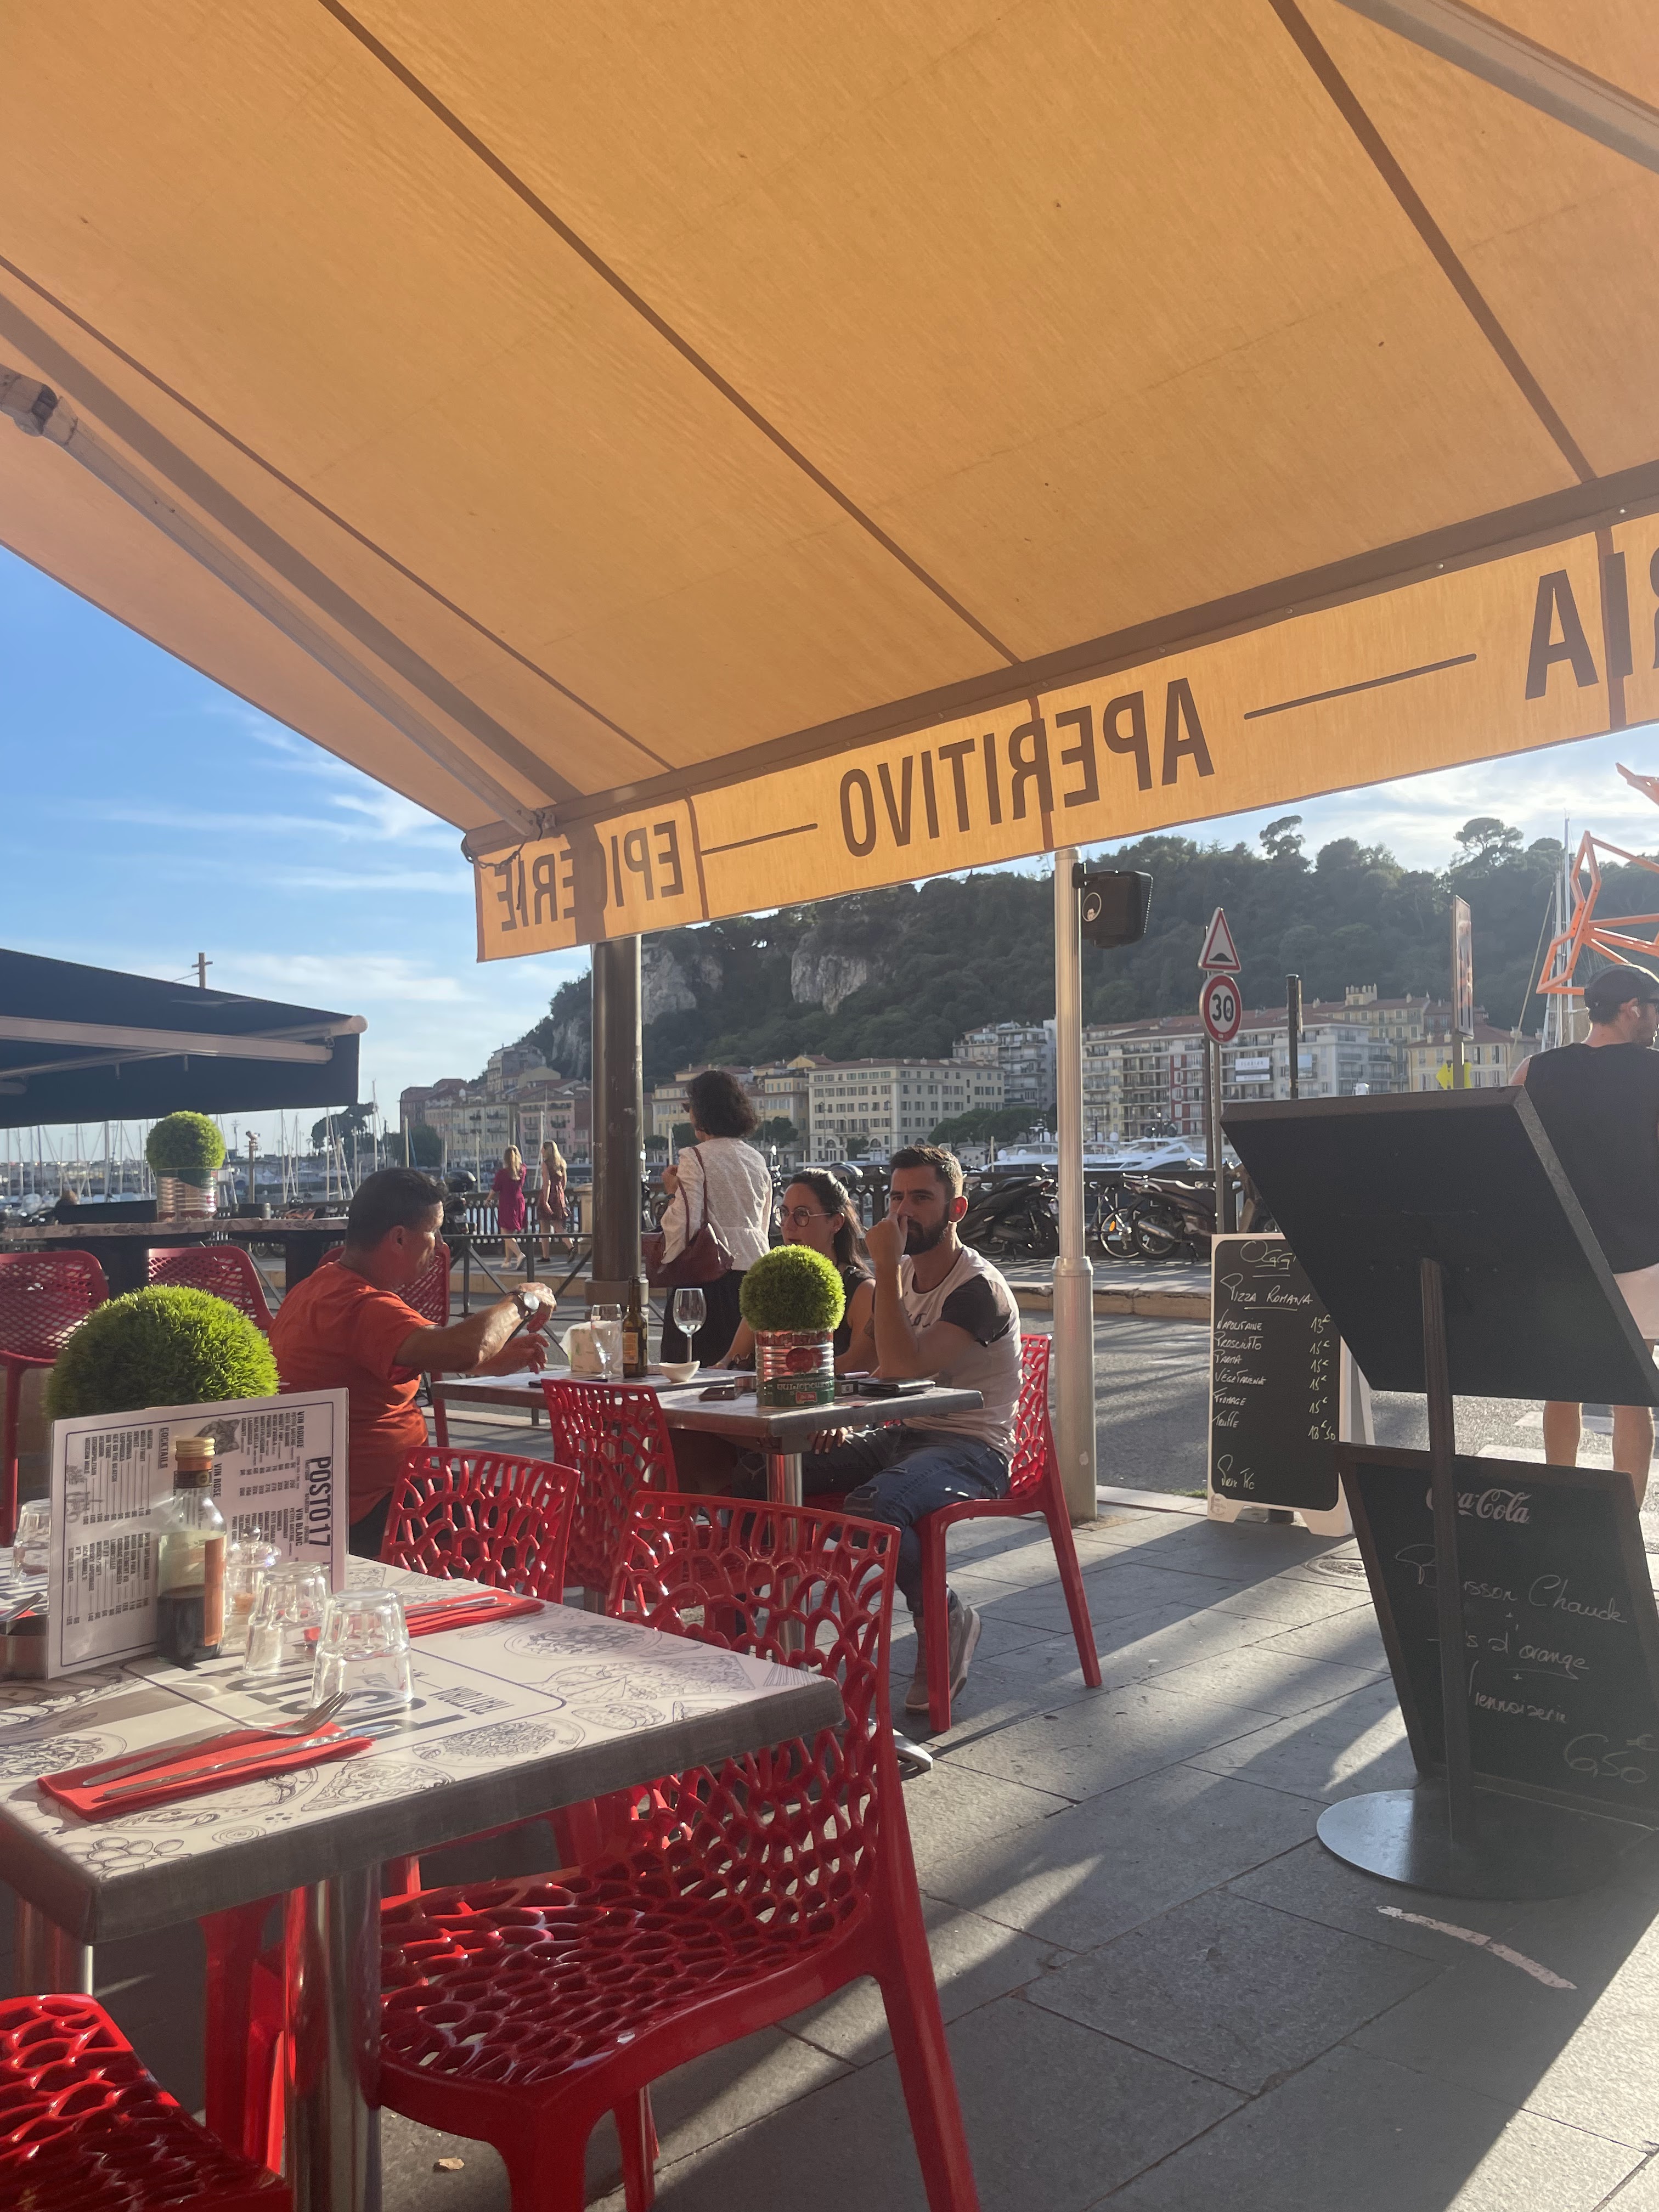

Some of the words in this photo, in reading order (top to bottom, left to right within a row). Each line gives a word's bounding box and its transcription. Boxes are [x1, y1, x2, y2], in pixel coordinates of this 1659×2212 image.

[1212, 994, 1234, 1022] 30
[1220, 1273, 1256, 1302] PIZZA
[1266, 1285, 1313, 1305] ROMANA
[1216, 1308, 1262, 1330] NAPOLITAINE
[1212, 1349, 1242, 1364] PARMA
[297, 1410, 305, 1424] VIN
[159, 1426, 169, 1469] COCKTAILS
[213, 1463, 222, 1476] VIN
[308, 1455, 332, 1523] POSTO
[295, 1507, 303, 1521] VIN
[295, 1521, 303, 1547] BLANC
[308, 1522, 331, 1550] 17
